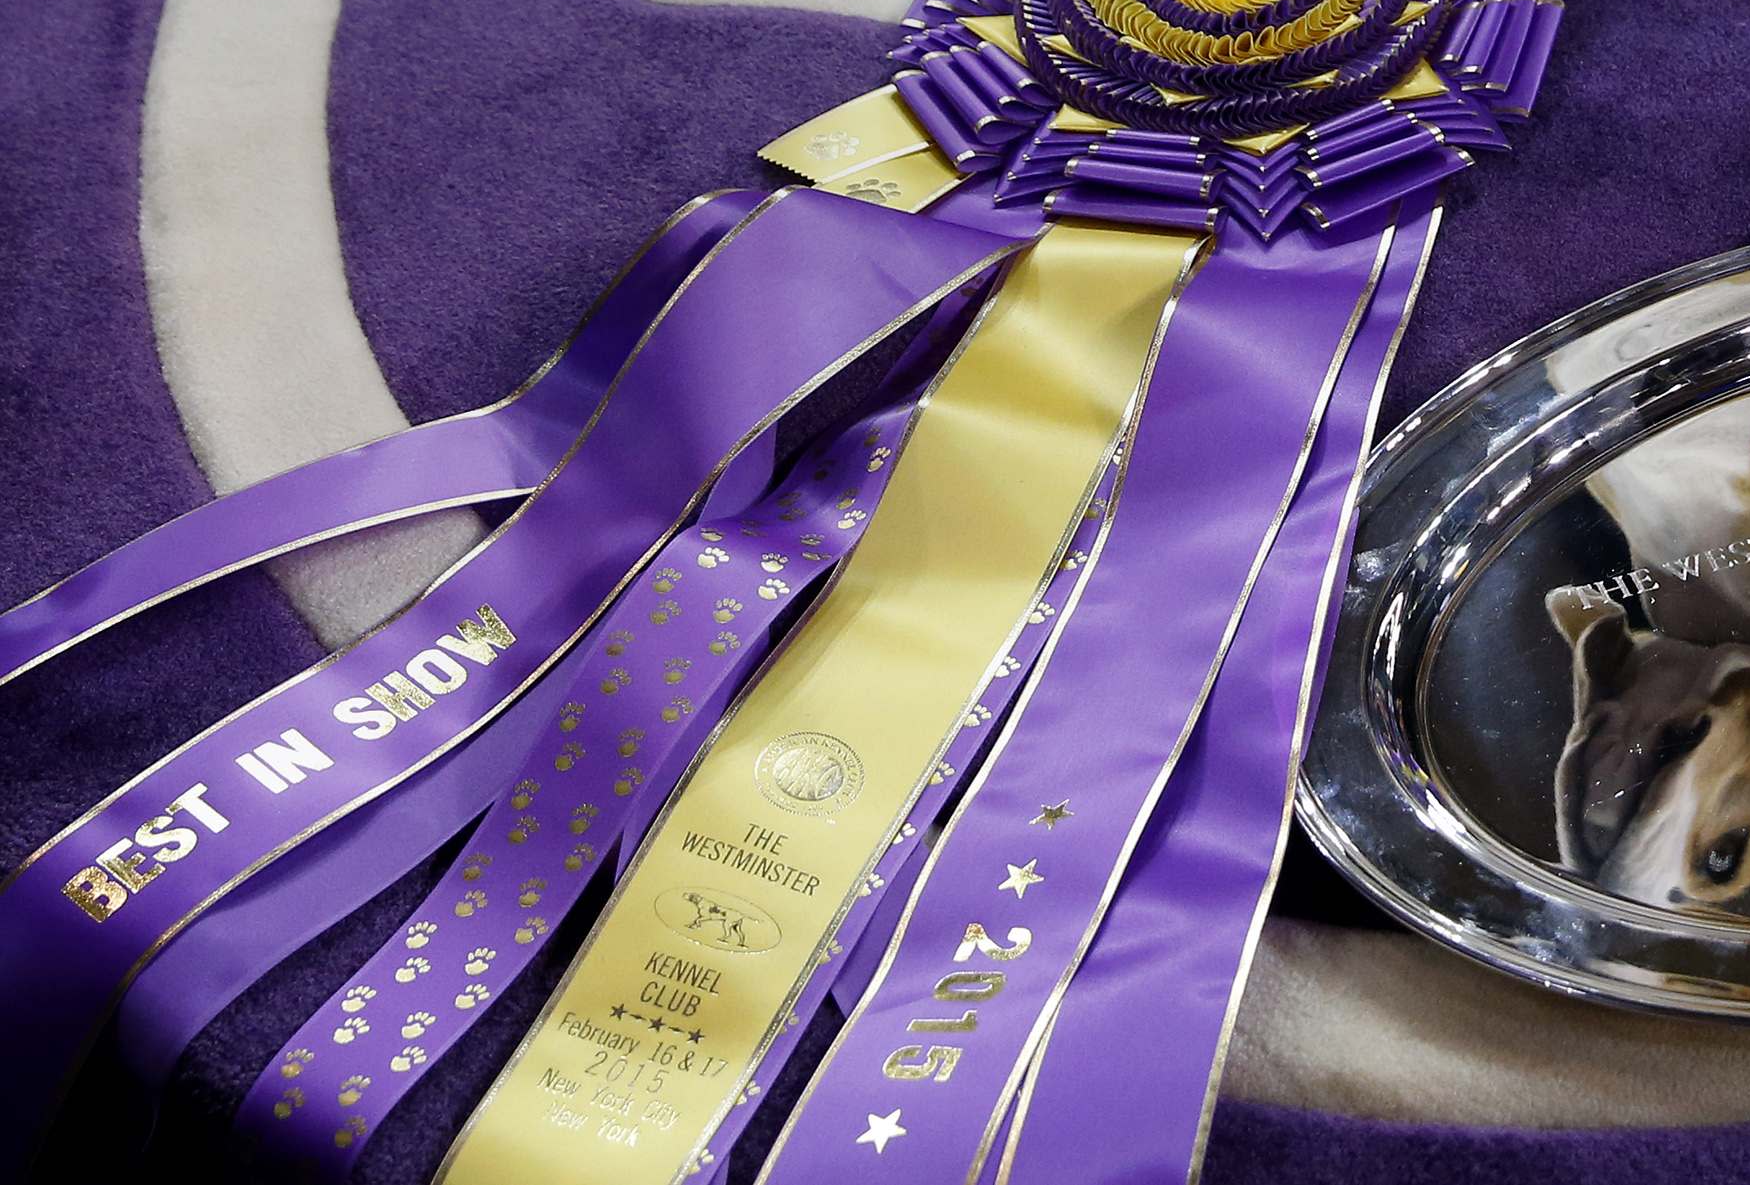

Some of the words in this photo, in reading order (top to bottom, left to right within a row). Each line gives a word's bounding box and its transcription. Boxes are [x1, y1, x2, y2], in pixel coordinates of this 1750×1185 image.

[1568, 567, 1660, 611] THE
[60, 782, 231, 923] BEST
[234, 727, 336, 795] IN
[332, 602, 518, 741] SHOW
[742, 822, 789, 856] THE
[681, 831, 821, 897] WESTMINSTER
[644, 951, 724, 996] KENNEL
[640, 981, 703, 1017] CLUB
[882, 922, 1034, 1083] 2015
[558, 1011, 640, 1057] February
[648, 1041, 678, 1066] 16
[677, 1050, 696, 1072] &
[699, 1056, 729, 1078] 17
[584, 1050, 670, 1094] 2015
[536, 1067, 583, 1099] New
[589, 1085, 635, 1117] York
[640, 1099, 681, 1131] City
[596, 1118, 641, 1147] York
